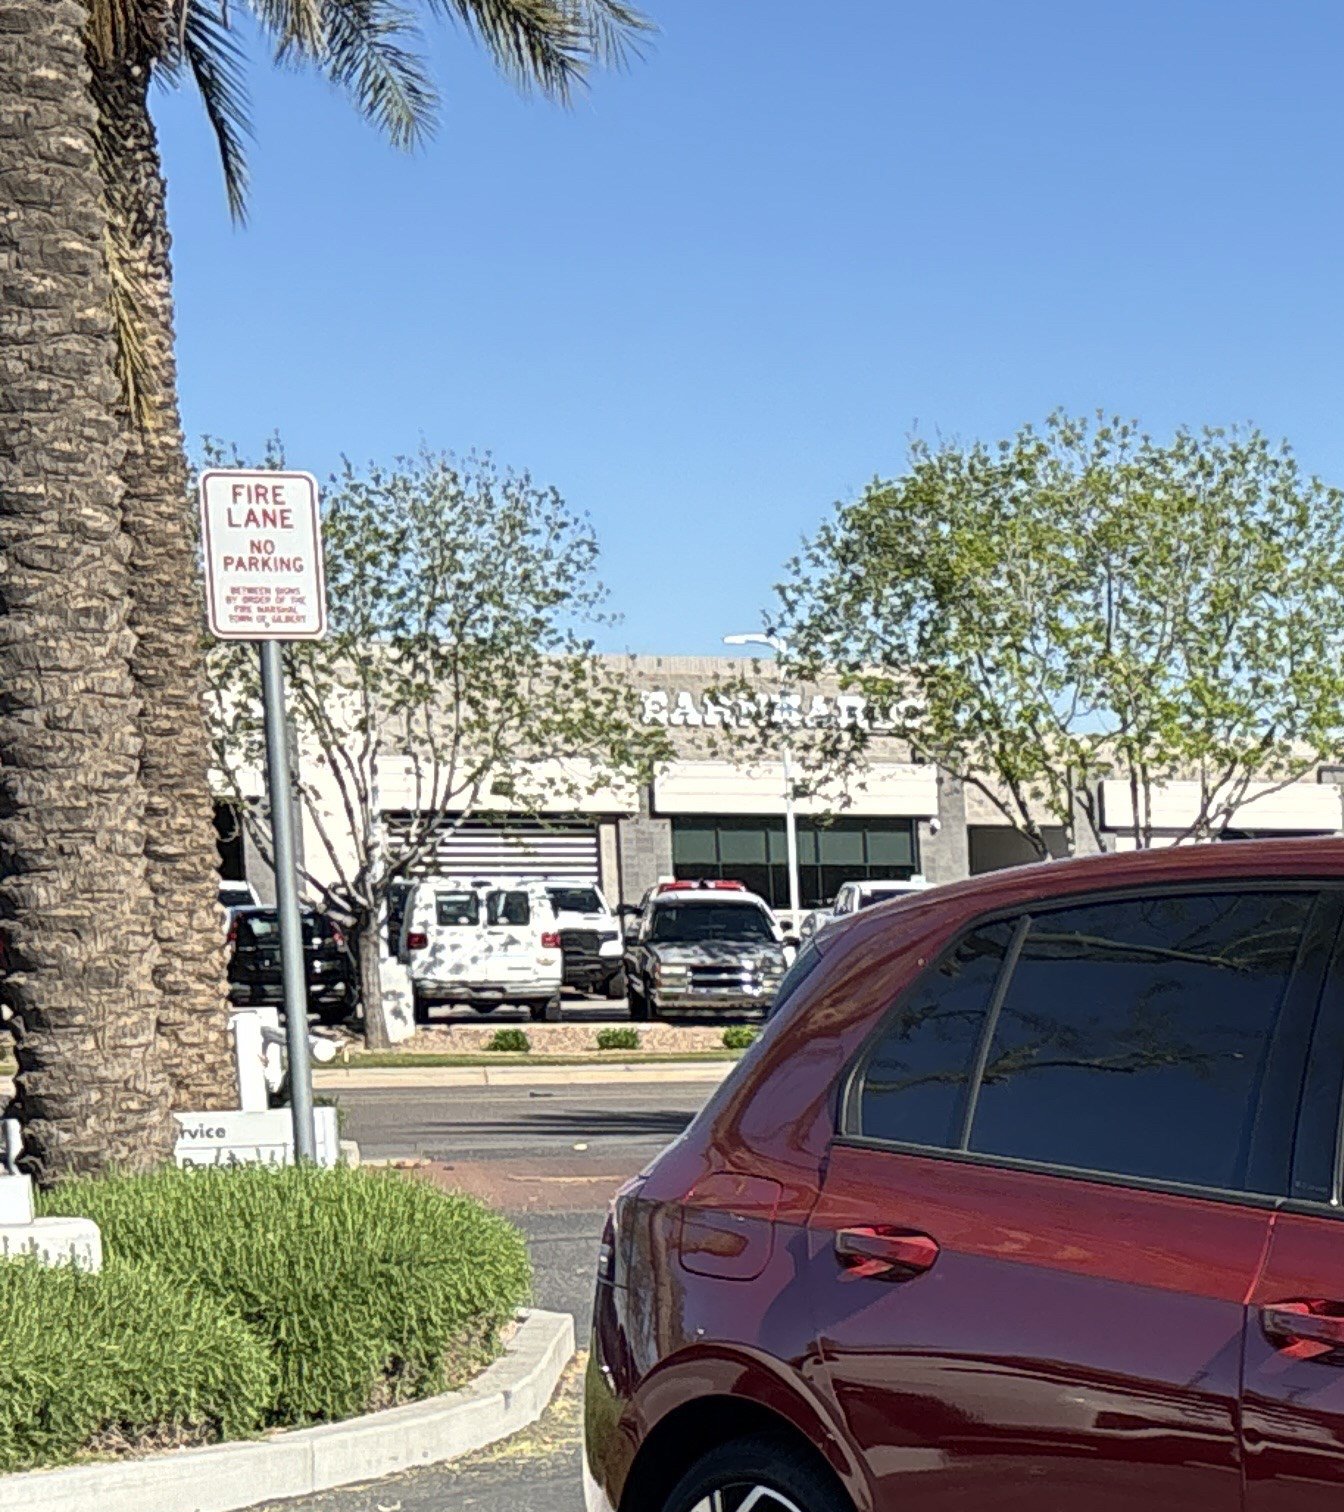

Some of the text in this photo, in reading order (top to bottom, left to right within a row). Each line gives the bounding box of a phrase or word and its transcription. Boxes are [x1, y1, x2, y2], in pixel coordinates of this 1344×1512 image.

[231, 483, 287, 506] FIRE
[226, 507, 294, 530] LANE
[249, 539, 276, 556] NO
[223, 555, 305, 573] PARKING
[178, 1122, 227, 1140] rvice
